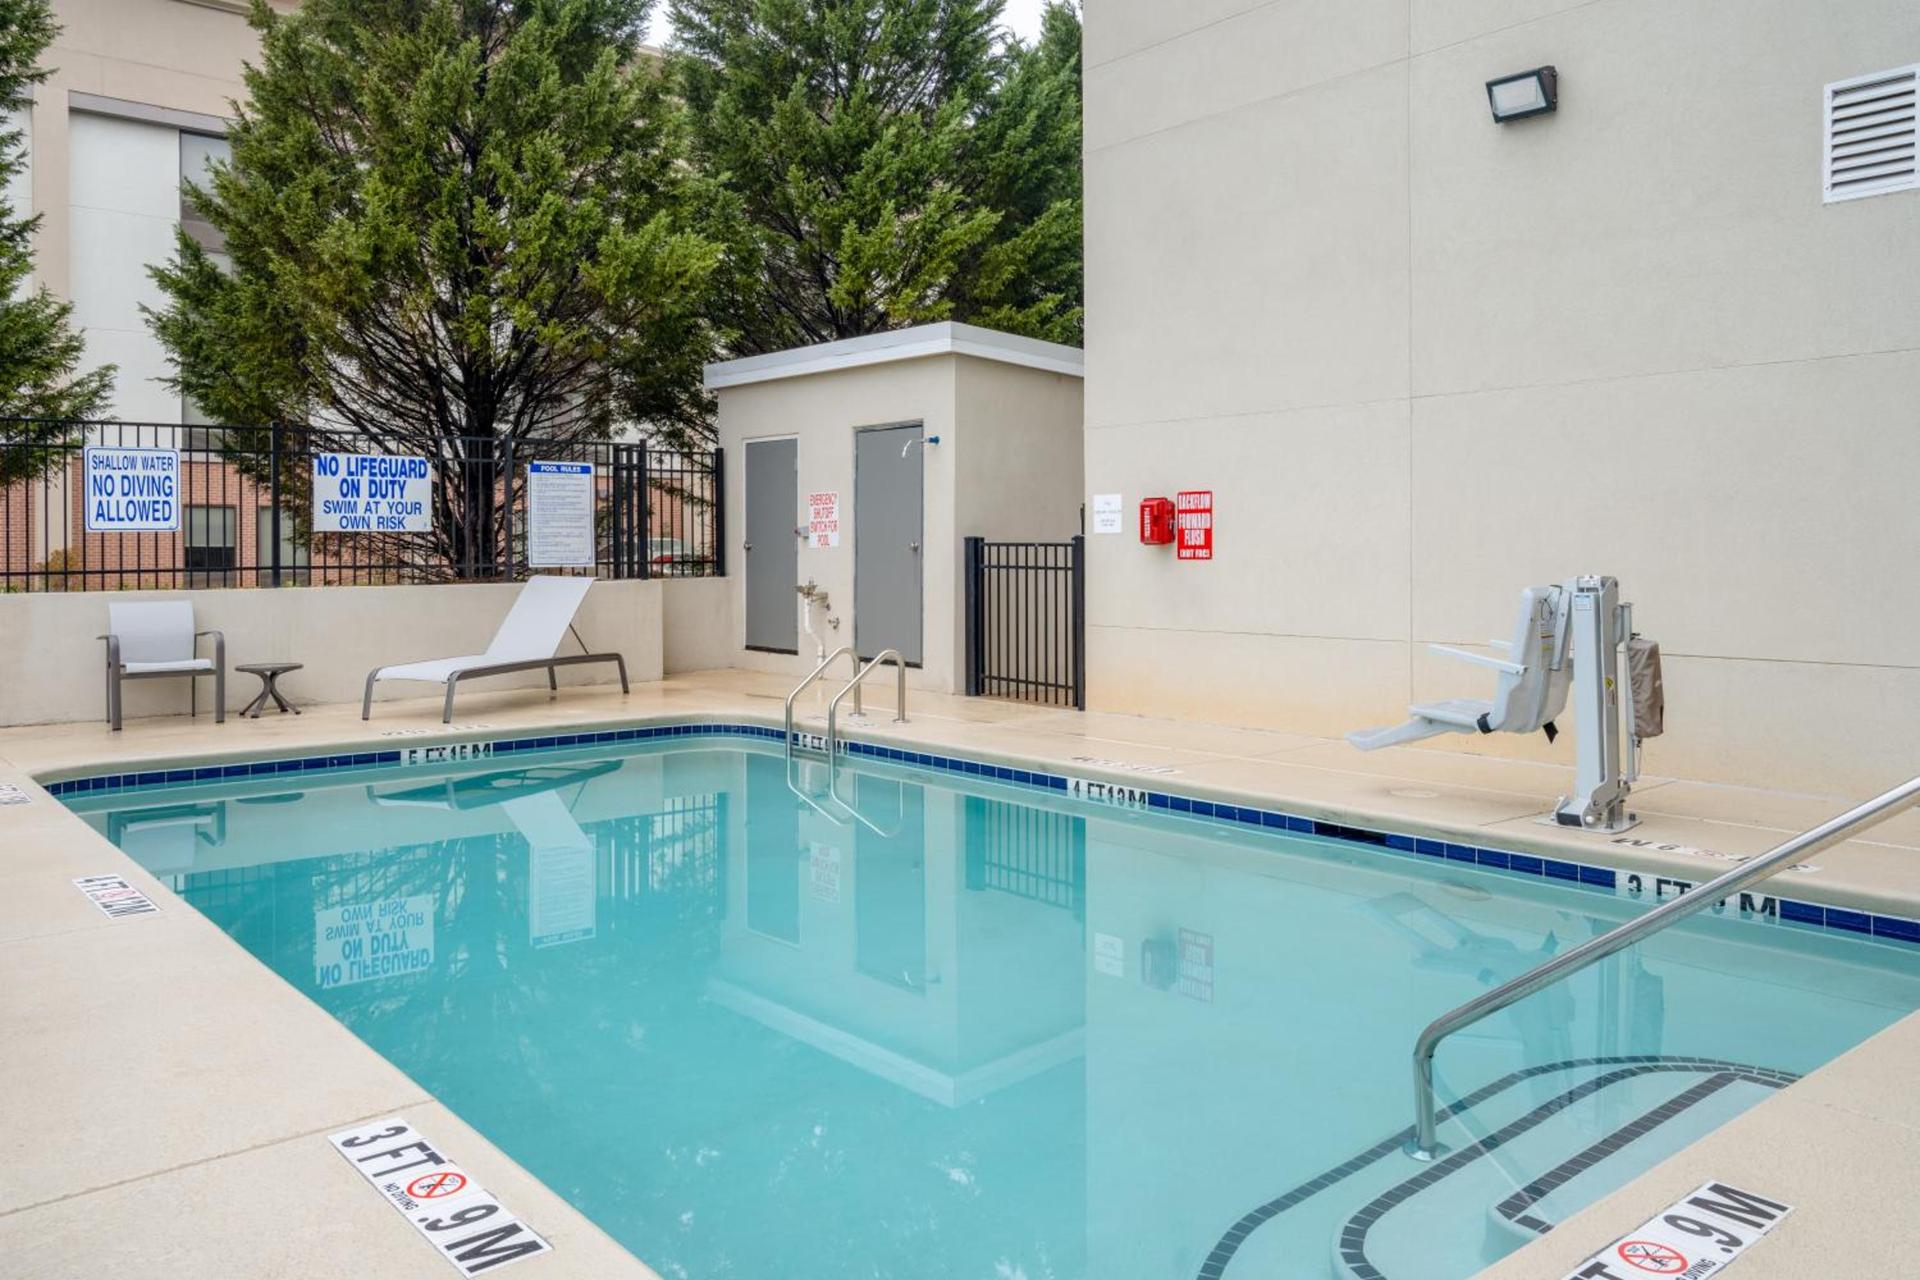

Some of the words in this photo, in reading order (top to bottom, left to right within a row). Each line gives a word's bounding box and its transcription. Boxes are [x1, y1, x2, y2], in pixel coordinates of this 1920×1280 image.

[92, 455, 137, 470] SHALLOW
[141, 456, 174, 471] WATER
[317, 455, 339, 477] NO
[347, 456, 427, 479] LIFEGUARD
[93, 474, 115, 497] NO
[121, 475, 173, 497] DIVING
[340, 478, 360, 498] ON
[368, 479, 407, 499] DUTY
[323, 500, 358, 514] SWIM
[364, 501, 380, 514] AT
[387, 502, 422, 515] YOUR
[810, 493, 837, 506] EMERGENCY
[95, 500, 172, 522] ALLOWED
[339, 515, 371, 530] OWN
[377, 516, 406, 530] RISK
[817, 534, 830, 545] POOL
[341, 1126, 409, 1148] 3
[357, 1141, 446, 1178] FT
[391, 1191, 419, 1210] DIVING
